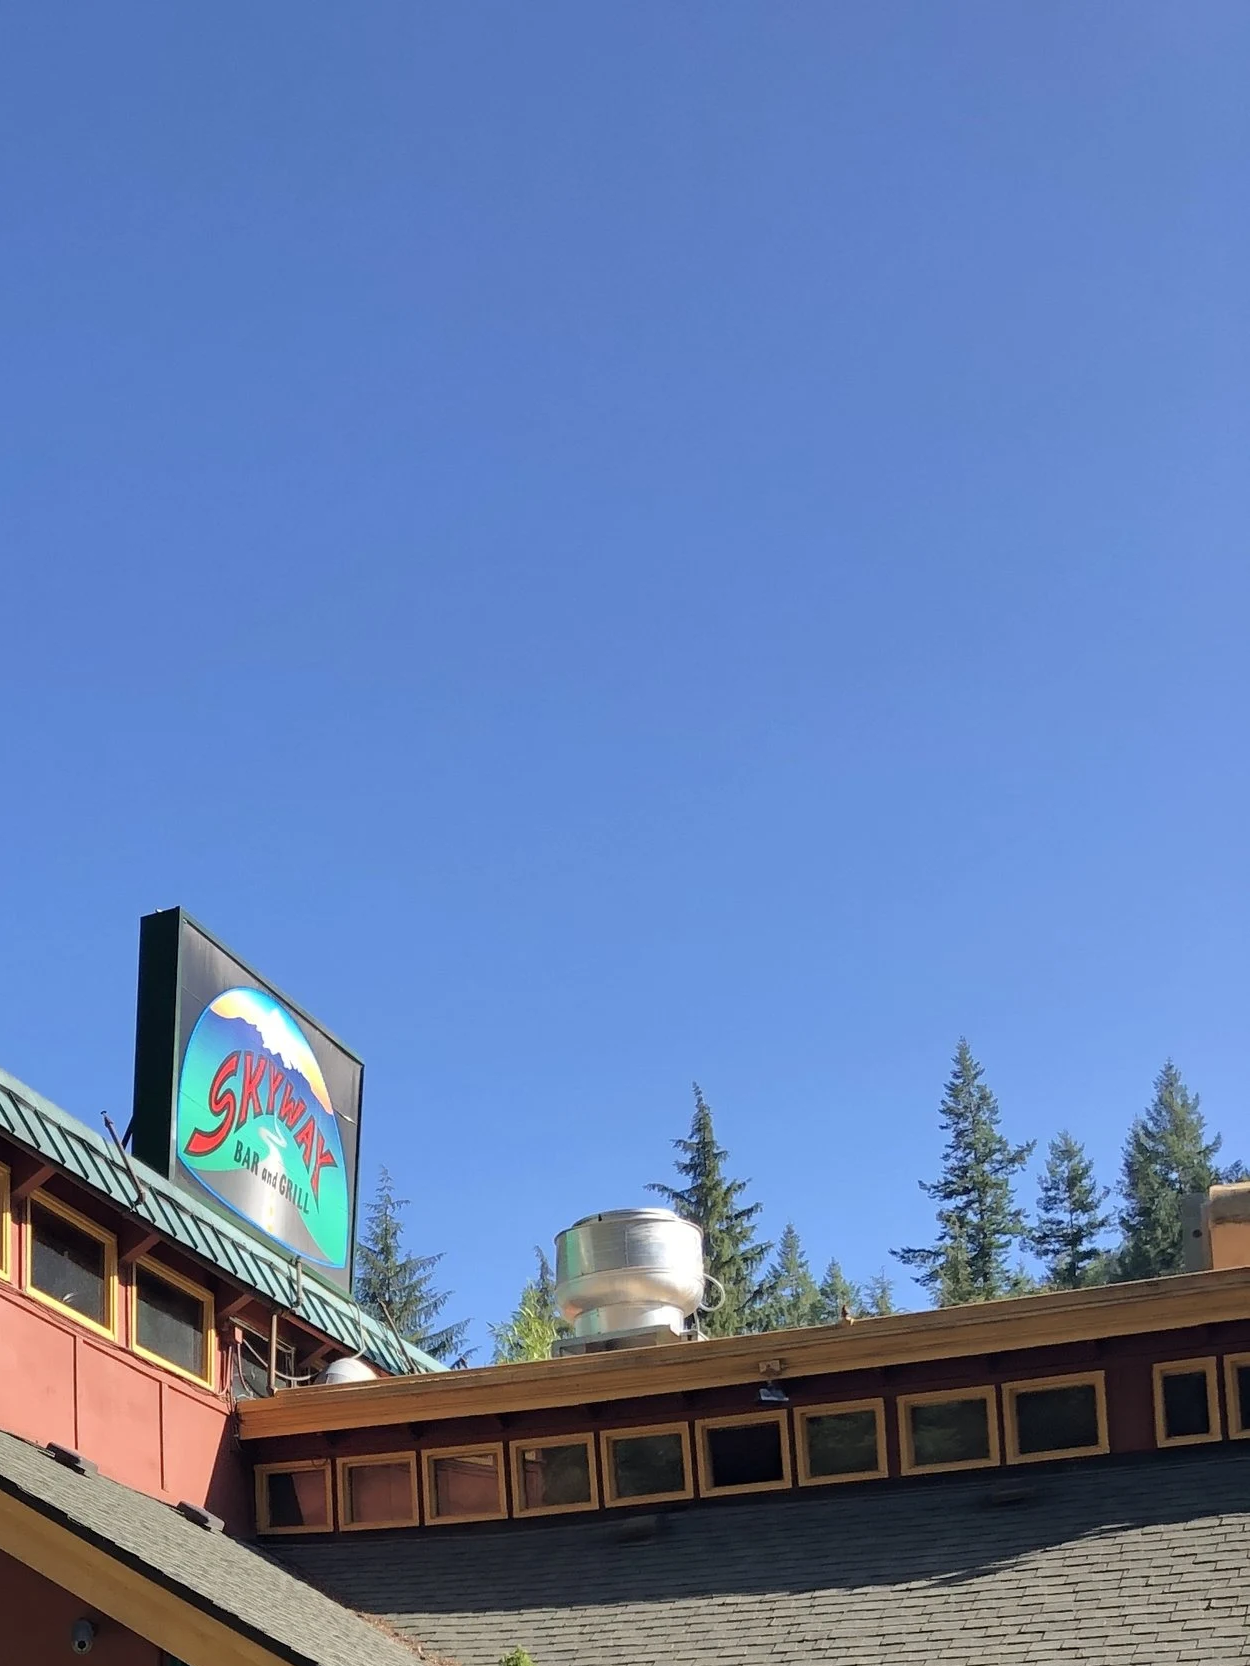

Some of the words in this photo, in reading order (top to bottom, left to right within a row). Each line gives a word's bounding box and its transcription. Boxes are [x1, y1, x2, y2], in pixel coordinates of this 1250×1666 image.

[184, 1050, 338, 1214] SKYWAY
[235, 1140, 260, 1175] BAR
[262, 1165, 277, 1191] and
[279, 1178, 310, 1215] GRILL
